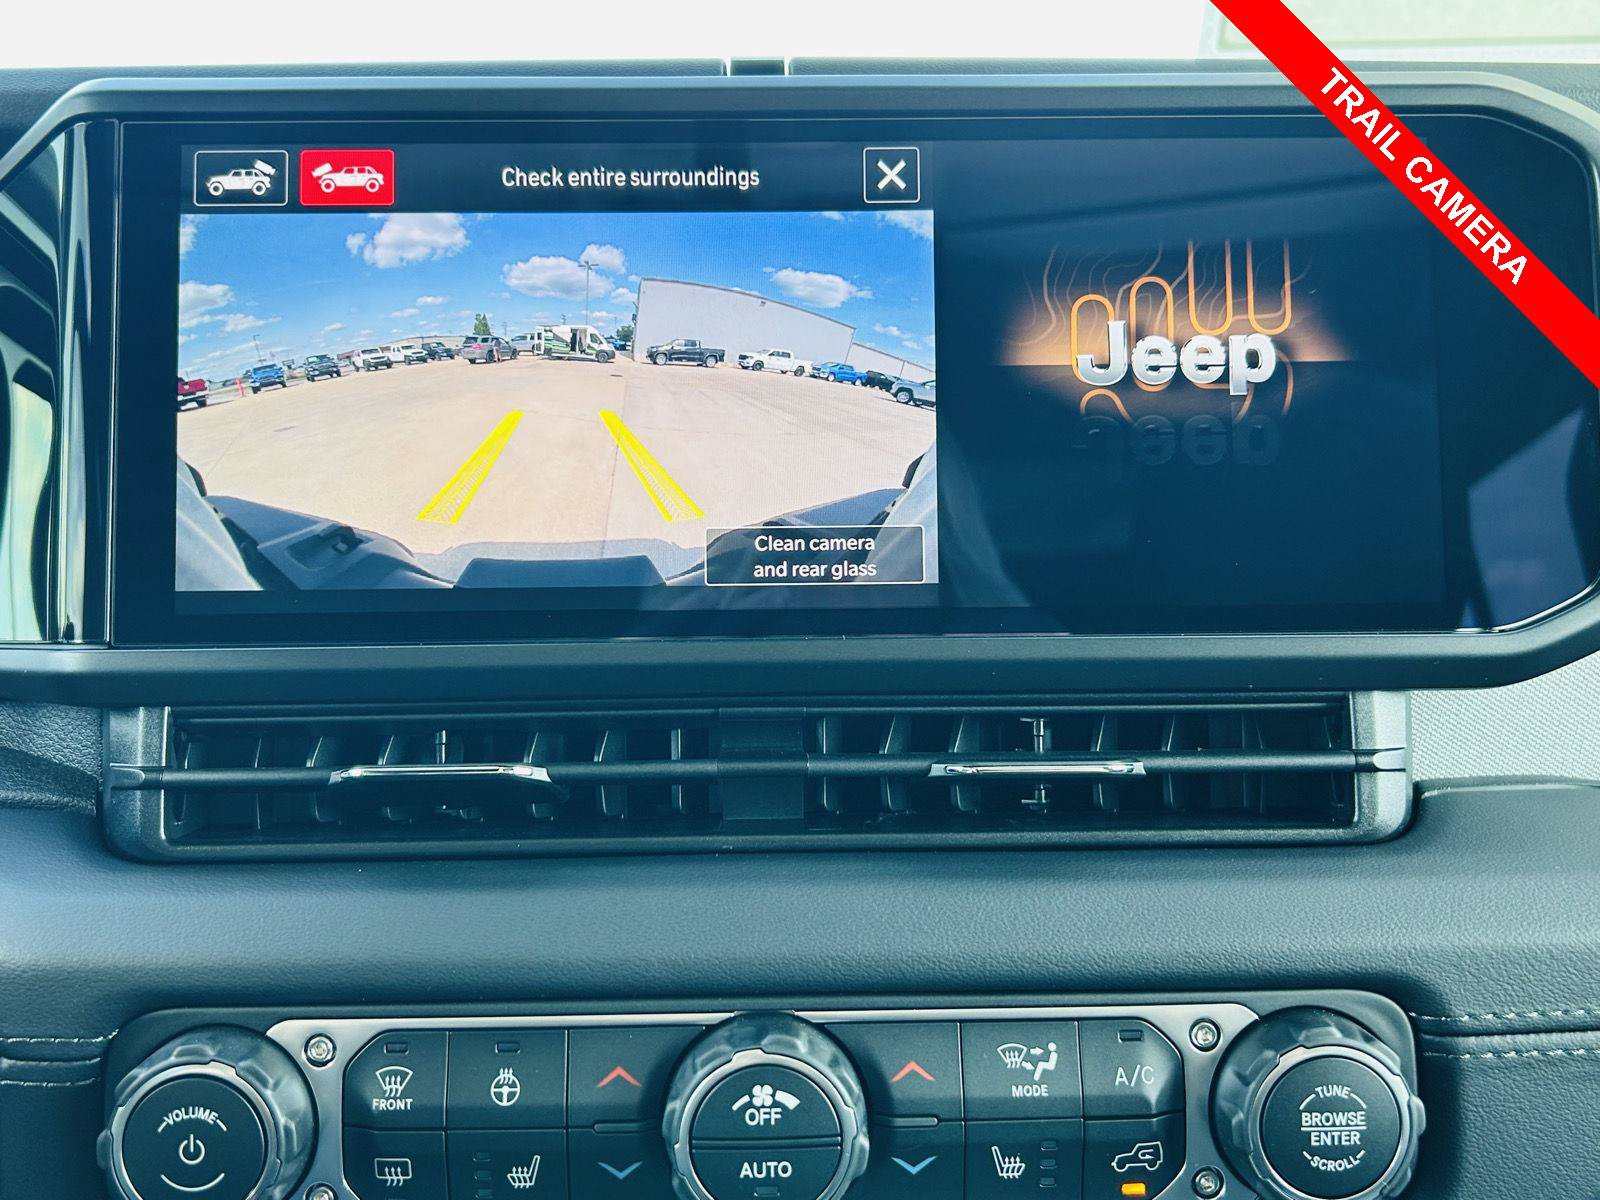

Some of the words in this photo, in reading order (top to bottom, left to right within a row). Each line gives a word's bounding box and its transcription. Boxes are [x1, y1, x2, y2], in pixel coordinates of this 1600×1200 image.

[501, 165, 563, 189] Check
[568, 166, 626, 189] entire
[629, 166, 761, 191] surroundings
[1076, 320, 1277, 396] Jeep
[754, 534, 806, 553] Clean
[809, 536, 876, 553] camera
[753, 561, 788, 579] and
[793, 563, 828, 579] rear
[832, 561, 877, 582] glass
[1114, 1064, 1156, 1087] A/C
[1011, 1084, 1050, 1098] MODE
[1315, 1084, 1352, 1100] TUNE
[372, 1097, 413, 1111] FRONT
[166, 1106, 218, 1126] VOLUME
[744, 1108, 782, 1126] OFF
[1301, 1111, 1367, 1127] BROWSE
[1310, 1130, 1361, 1146] ENTER
[740, 1161, 793, 1179] AUTO
[1310, 1155, 1361, 1172] SCROLL
